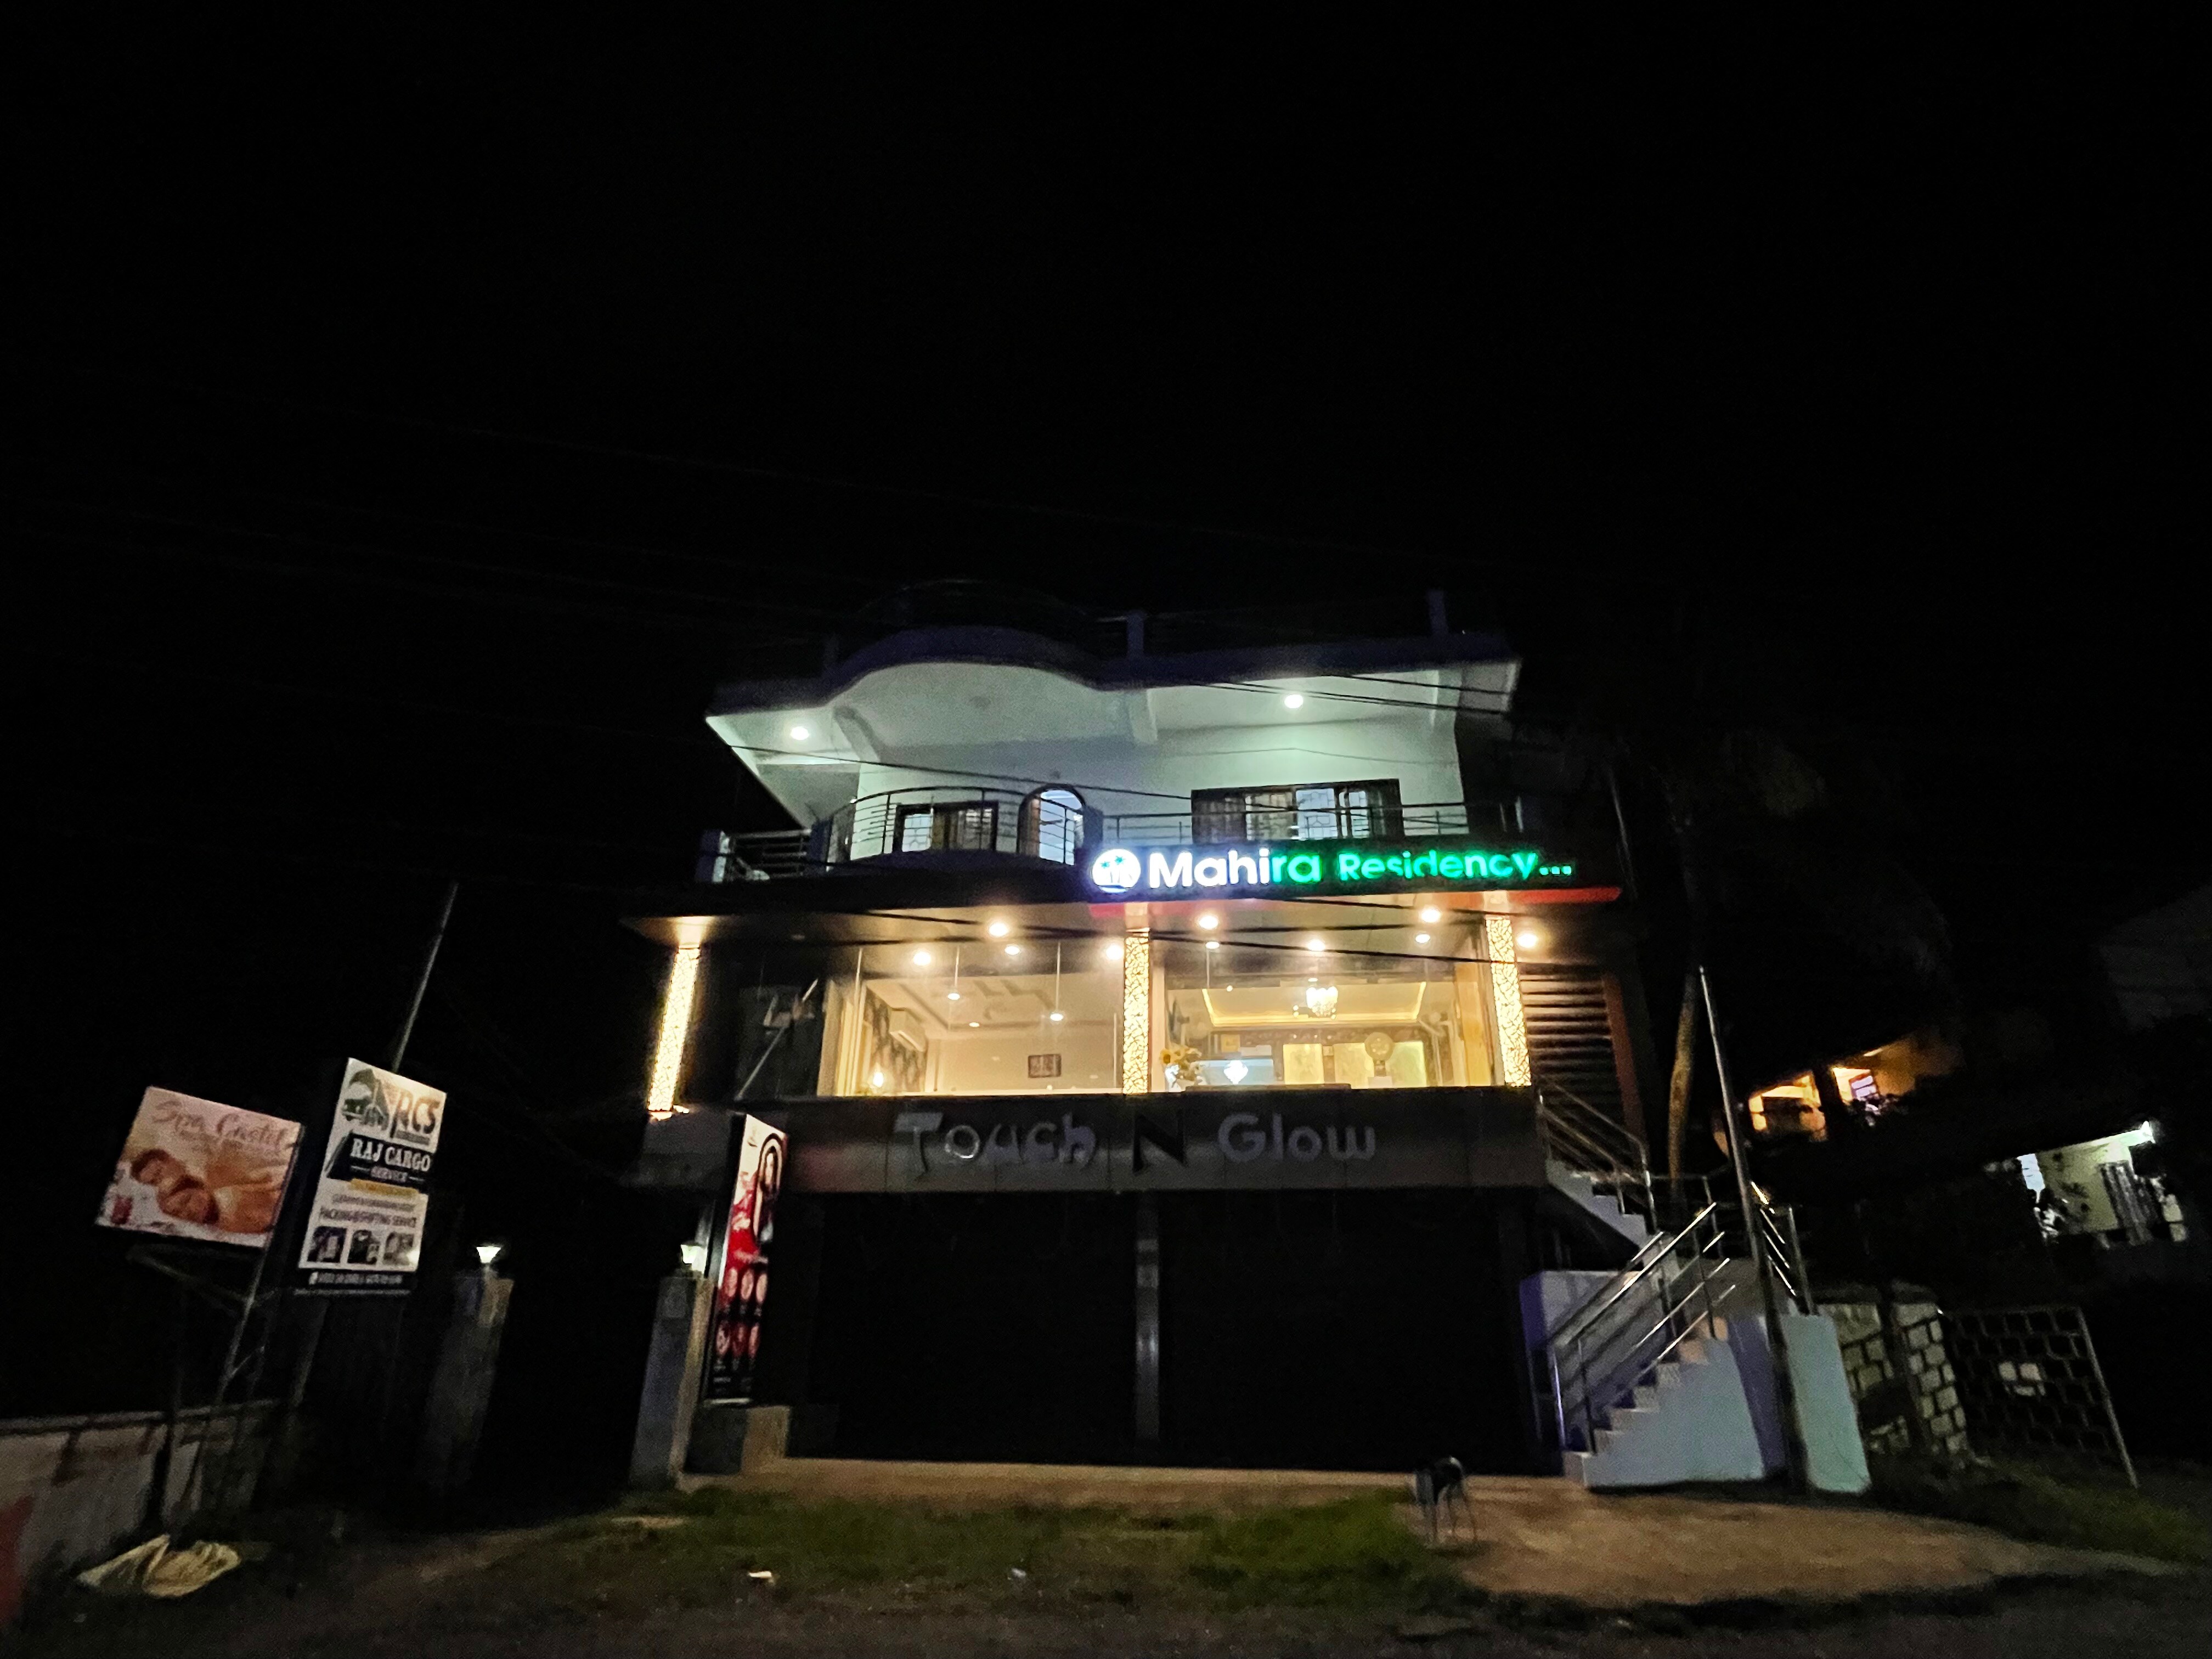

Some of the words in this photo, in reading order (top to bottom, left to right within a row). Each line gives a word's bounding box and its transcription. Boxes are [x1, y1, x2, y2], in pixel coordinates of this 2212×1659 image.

[1150, 848, 1322, 888] Mahira
[349, 1137, 384, 1162] RAJ
[385, 1146, 431, 1172] CARGO
[894, 1111, 1096, 1181] Touch
[1132, 1109, 1187, 1174] N
[1217, 1111, 1378, 1163] Glow
